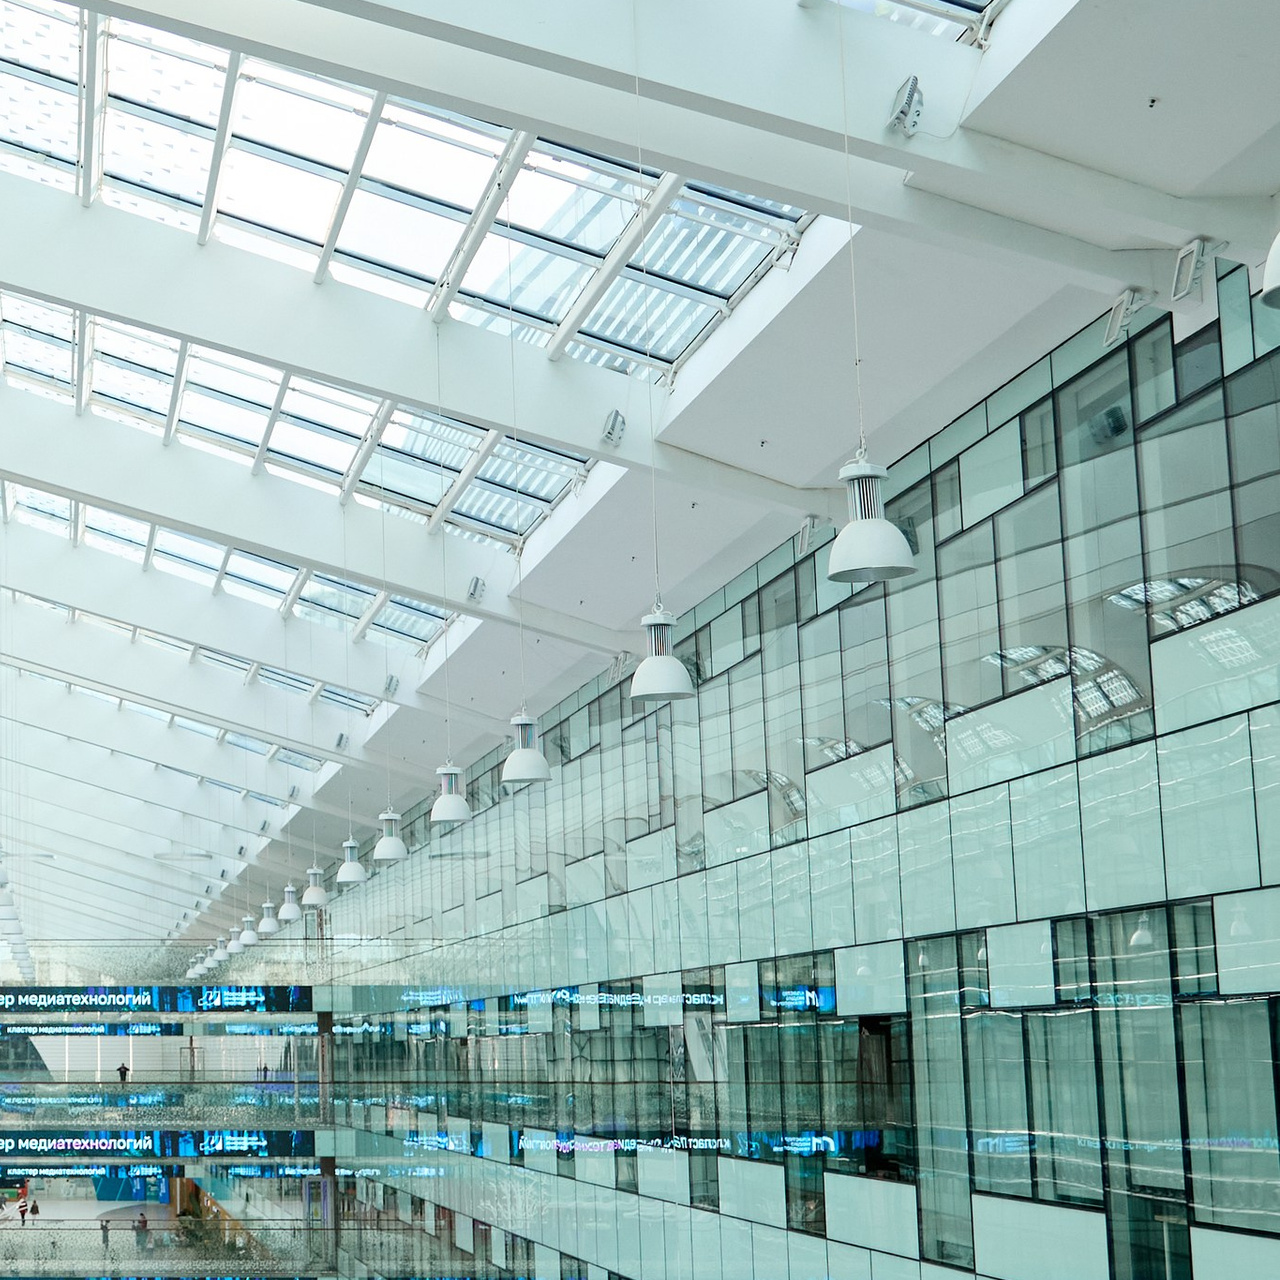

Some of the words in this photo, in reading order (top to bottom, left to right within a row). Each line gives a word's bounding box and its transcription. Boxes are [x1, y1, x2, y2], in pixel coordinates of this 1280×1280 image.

[17, 992, 151, 1009] медиатехнологий
[6, 1026, 38, 1036] кластер
[17, 1136, 153, 1152] медиатехнологий
[7, 1169, 38, 1180] кластер
